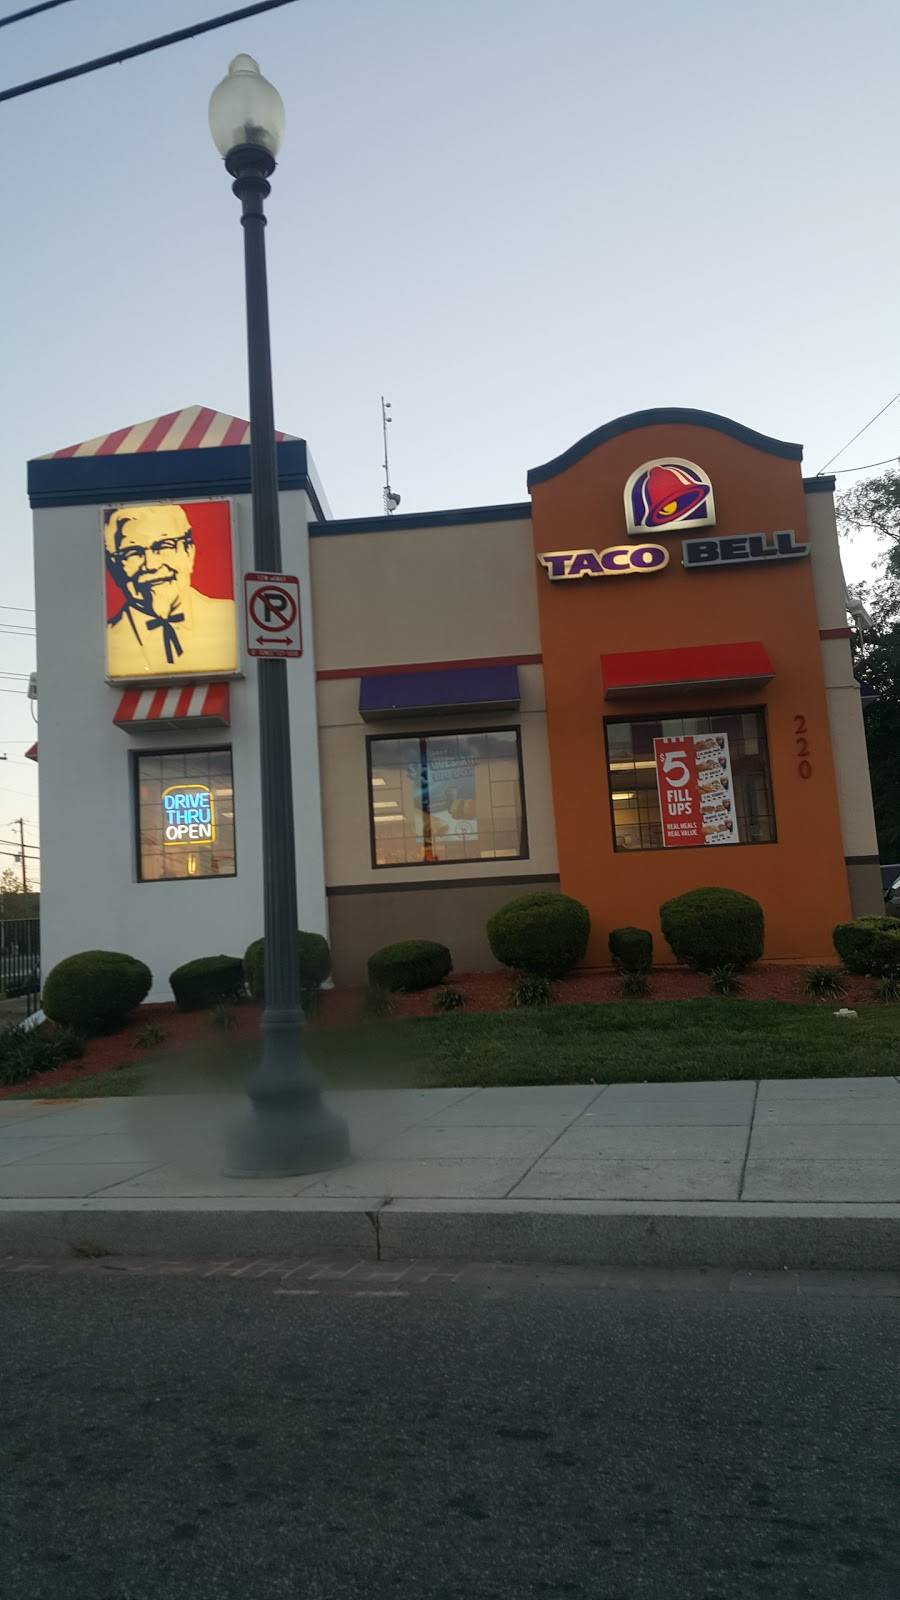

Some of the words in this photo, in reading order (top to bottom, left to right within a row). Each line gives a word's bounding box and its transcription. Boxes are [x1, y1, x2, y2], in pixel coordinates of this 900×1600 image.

[543, 546, 666, 577] TACO
[686, 533, 807, 564] BELL
[793, 714, 812, 779] 220
[164, 792, 210, 810] DRIVE
[667, 789, 692, 802] FILL
[166, 808, 211, 825] THRU
[668, 803, 692, 815] UPS
[165, 824, 212, 840] OPEN
